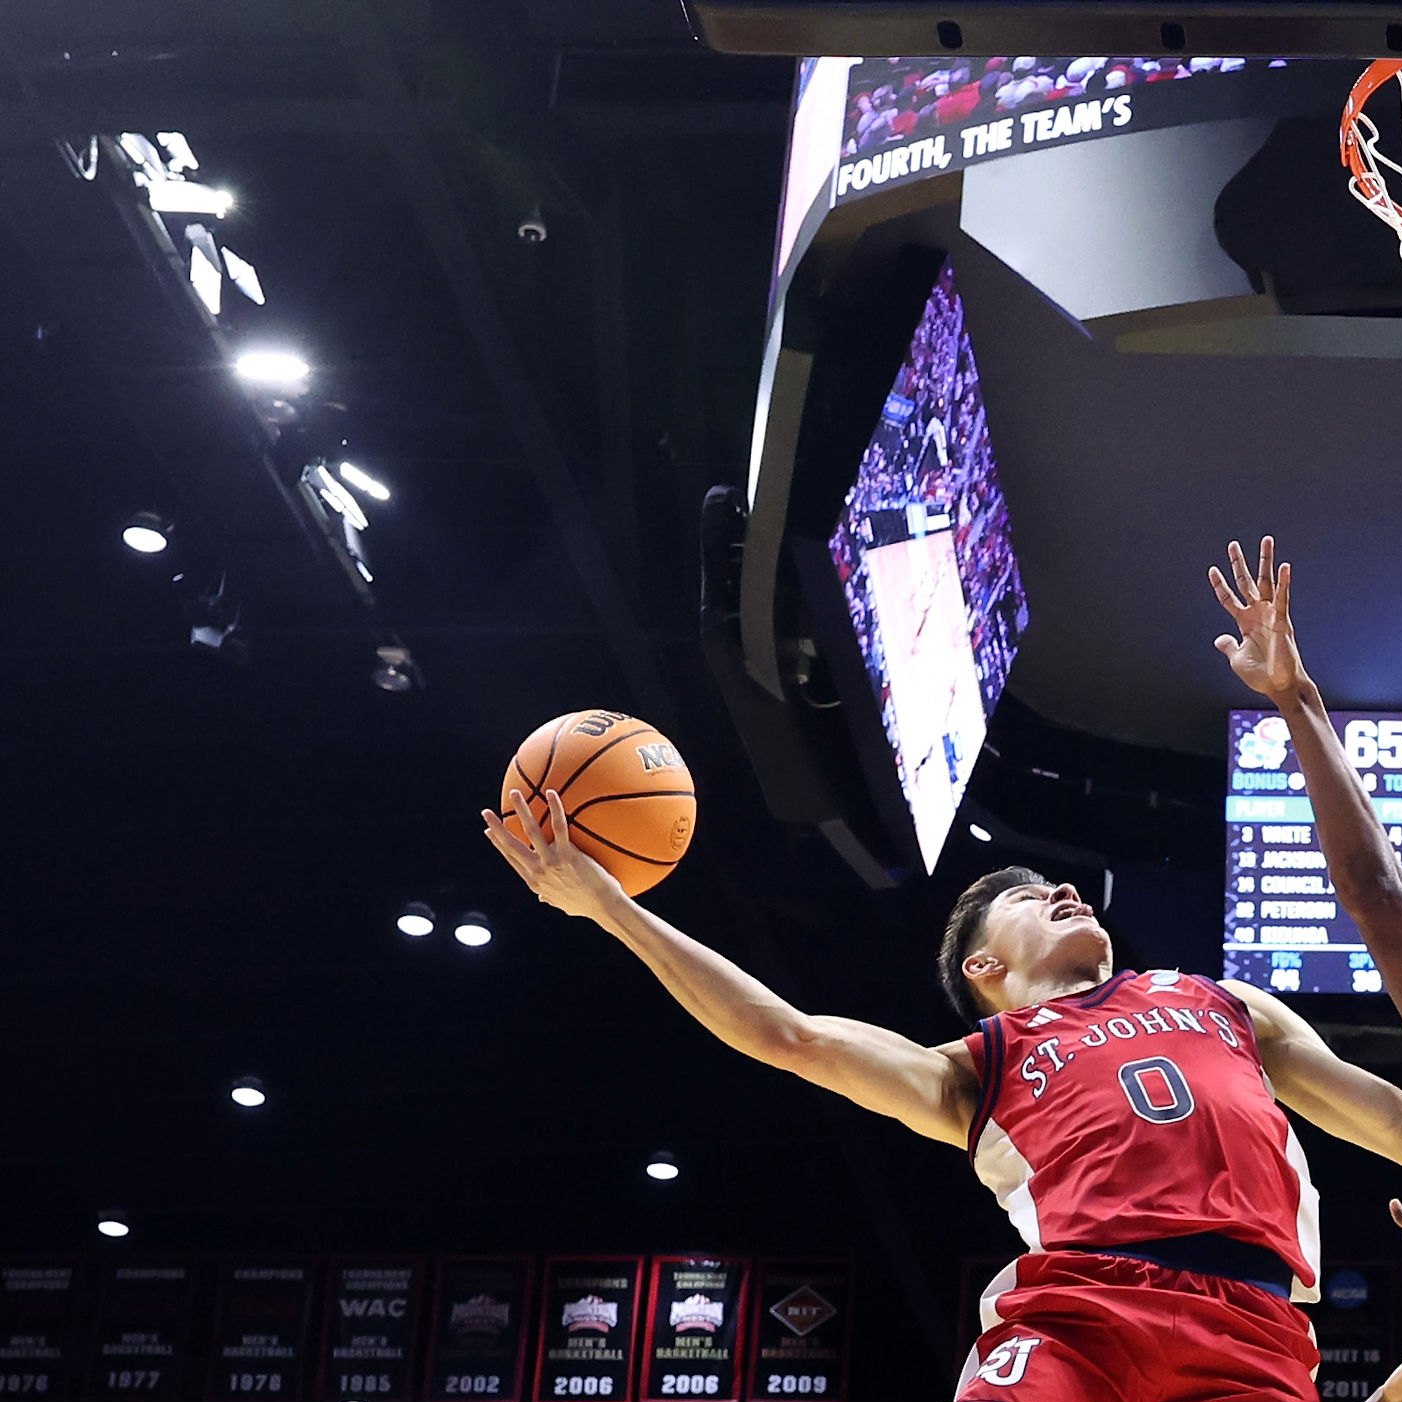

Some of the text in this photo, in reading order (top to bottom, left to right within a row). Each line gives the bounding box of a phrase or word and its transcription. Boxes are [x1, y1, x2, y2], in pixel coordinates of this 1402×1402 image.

[837, 95, 1132, 196] FOURTH, THE TEAM'S
[1232, 773, 1288, 791] BONUS
[1020, 1007, 1240, 1100] ST. JOHN'S
[1117, 1055, 1196, 1125] 0
[339, 1299, 408, 1318] WAC
[445, 1374, 502, 1394] 2002
[553, 1374, 614, 1397] 2006
[660, 1373, 721, 1396] 2006
[766, 1374, 828, 1395] 2009
[1322, 1379, 1369, 1399] 2011
